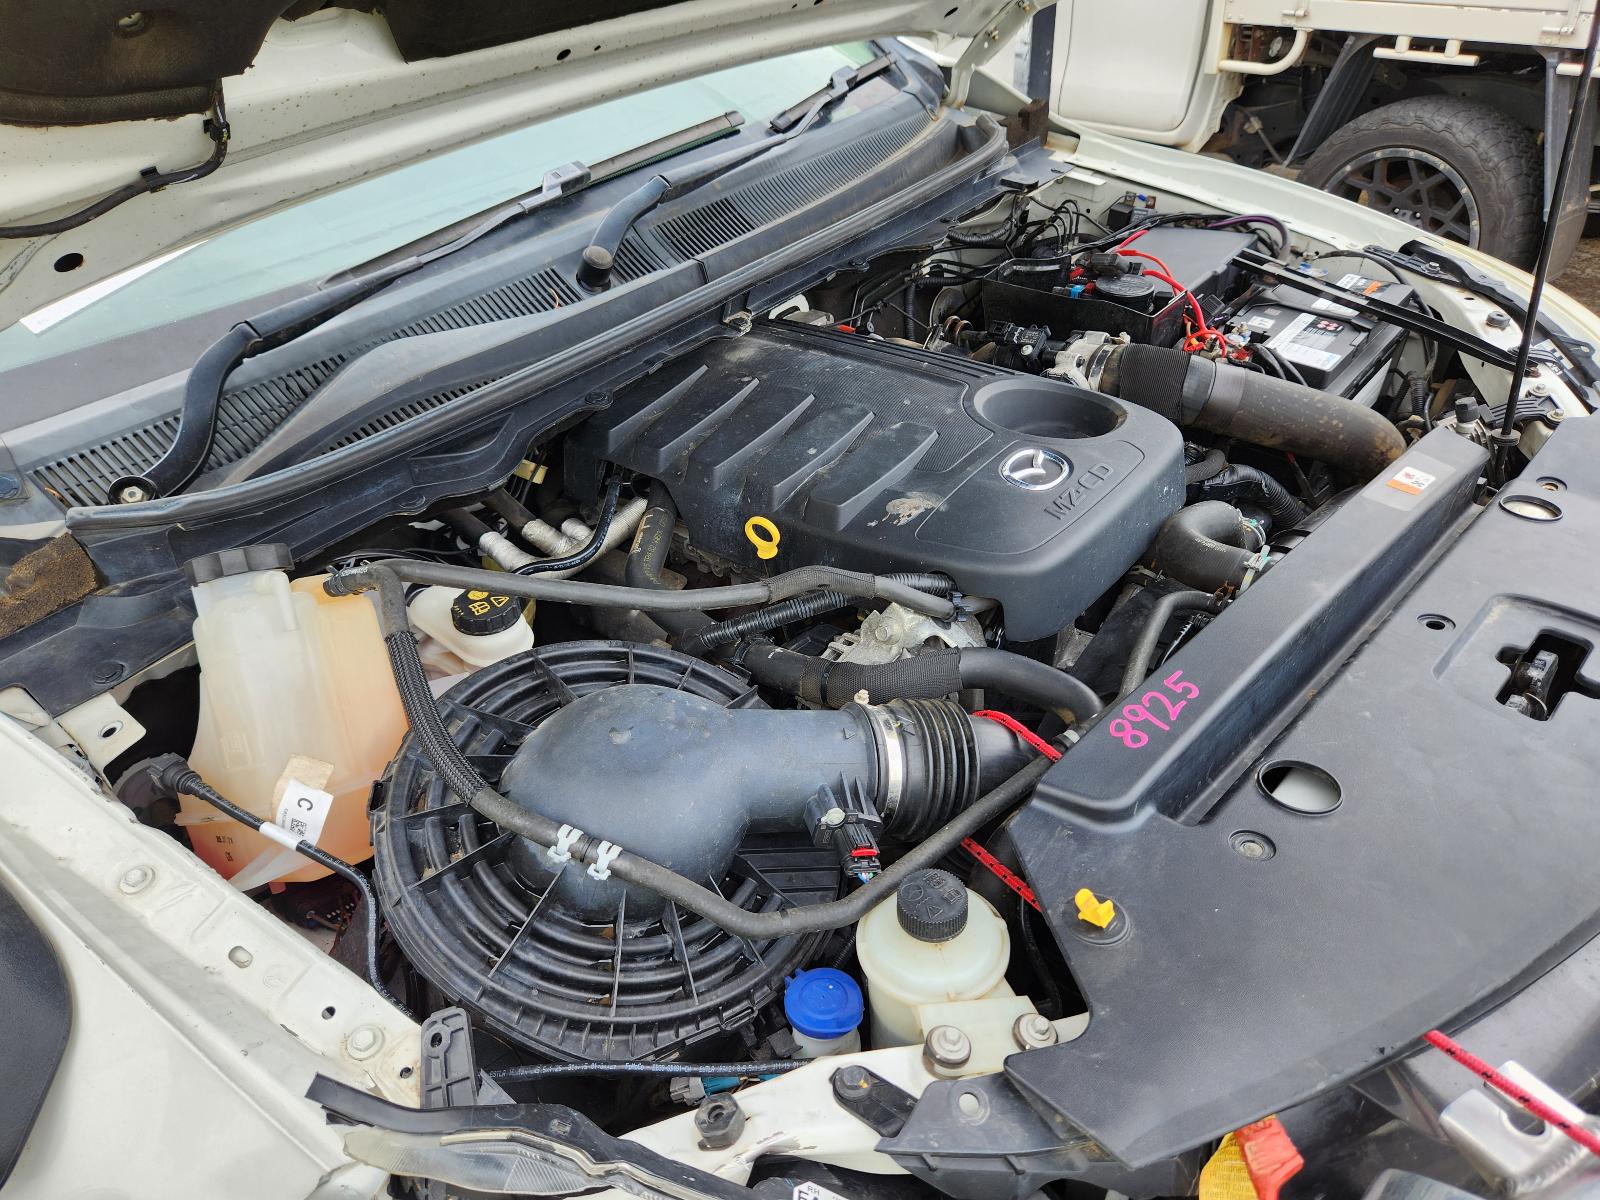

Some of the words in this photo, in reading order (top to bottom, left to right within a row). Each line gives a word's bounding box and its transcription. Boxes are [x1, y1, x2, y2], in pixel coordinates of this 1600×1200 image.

[1044, 463, 1114, 520] MZ-CD
[1109, 670, 1200, 748] 8925
[297, 797, 313, 811] C
